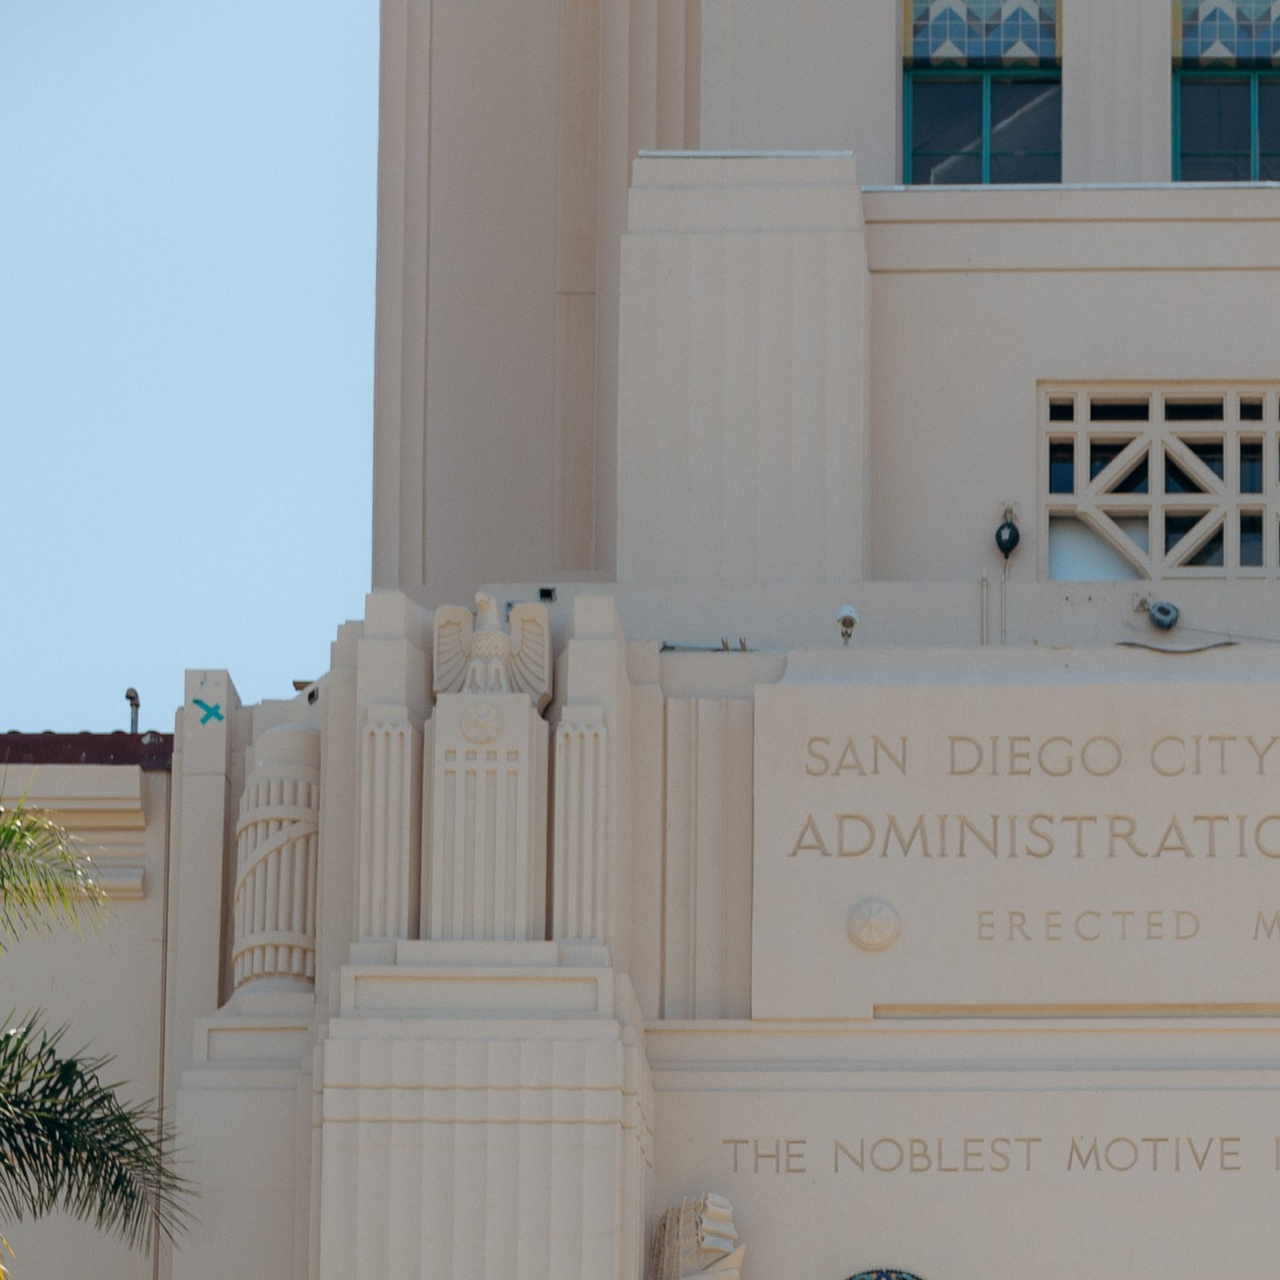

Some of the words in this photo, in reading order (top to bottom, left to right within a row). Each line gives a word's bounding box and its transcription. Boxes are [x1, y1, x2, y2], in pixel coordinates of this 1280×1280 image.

[805, 736, 910, 778] SAN
[949, 736, 1123, 778] DIEGO
[1151, 735, 1280, 778] CITY
[976, 911, 1202, 942] ERECTED
[722, 1138, 808, 1175] THE
[834, 1137, 1043, 1175] NOBLEST
[1066, 1136, 1243, 1174] MOTIVE
